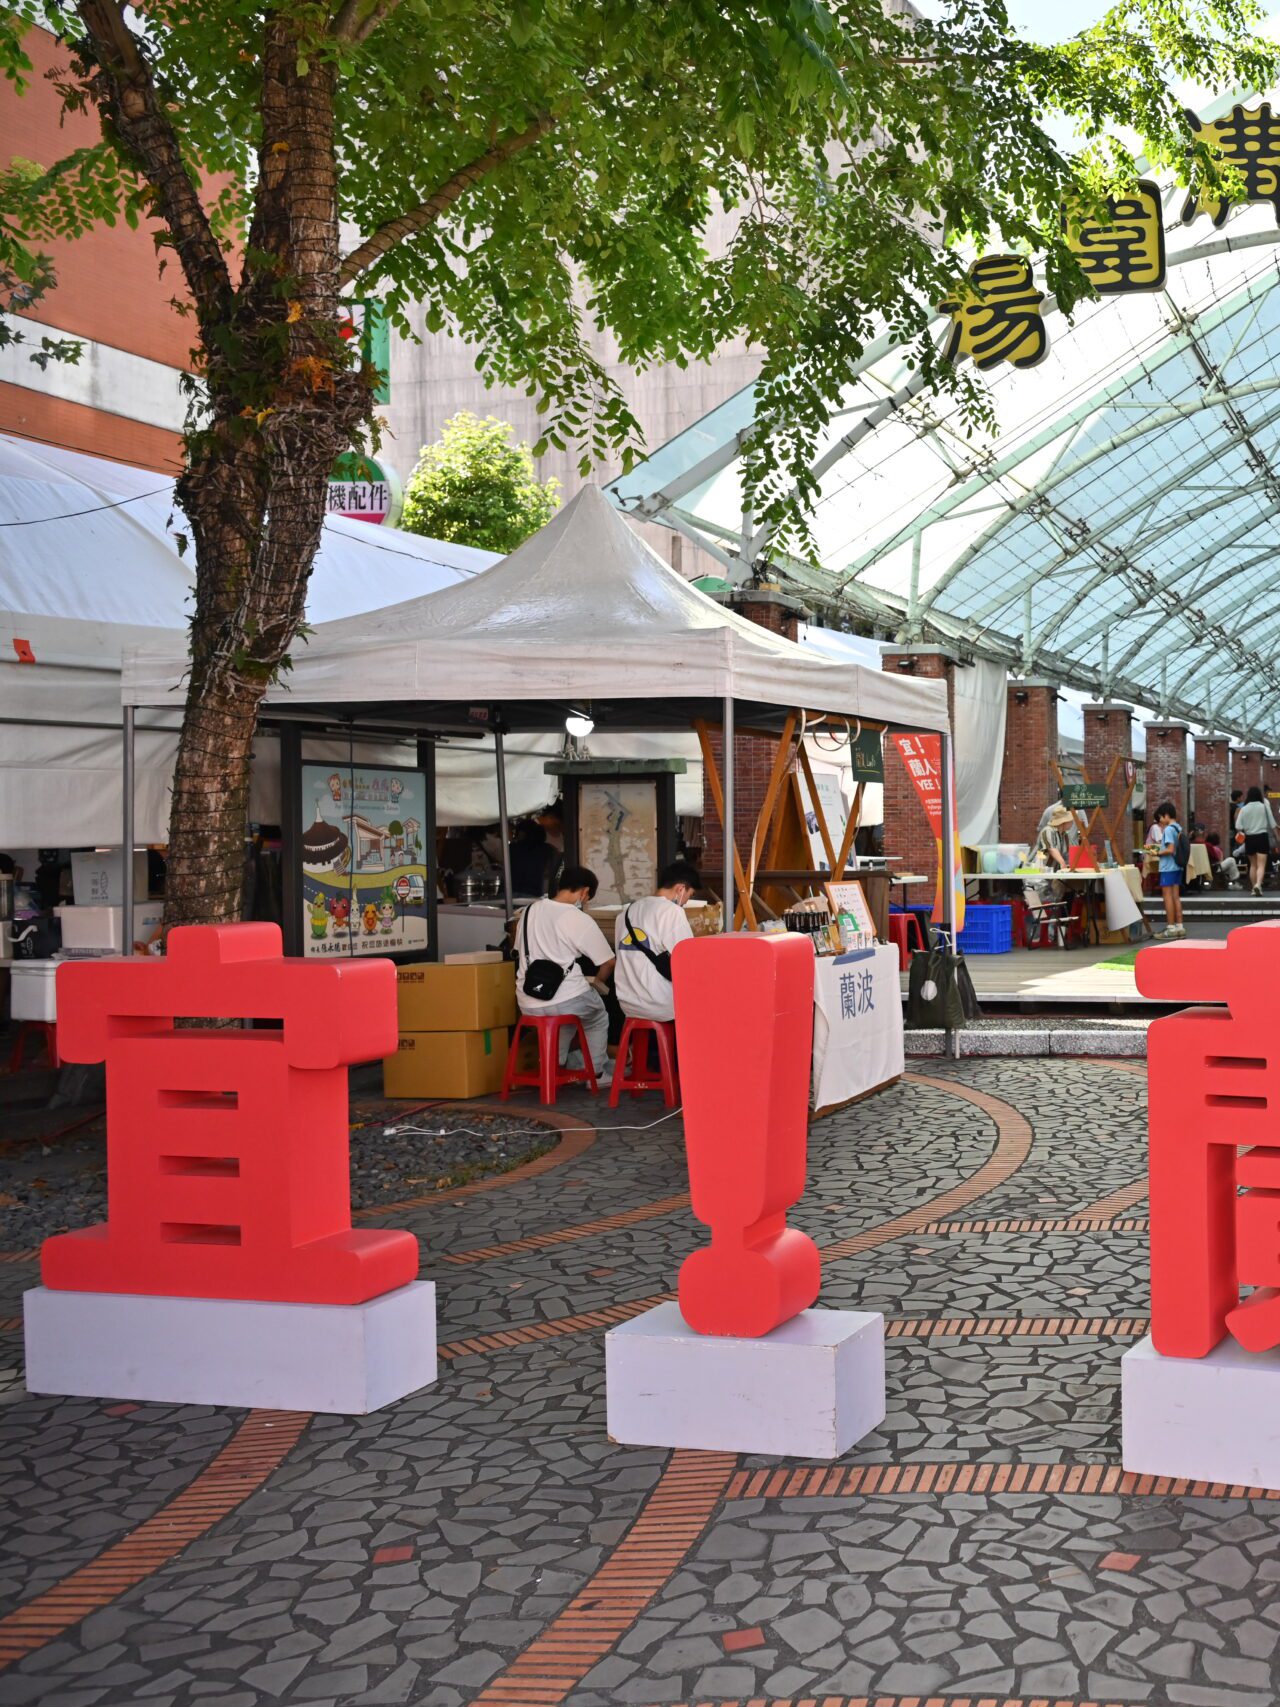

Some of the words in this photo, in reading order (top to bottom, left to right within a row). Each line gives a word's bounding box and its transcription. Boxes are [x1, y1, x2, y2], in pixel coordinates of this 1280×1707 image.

[898, 736, 925, 757] 宜！
[839, 968, 875, 1020] 蘭波
[41, 921, 420, 1305] 宜
